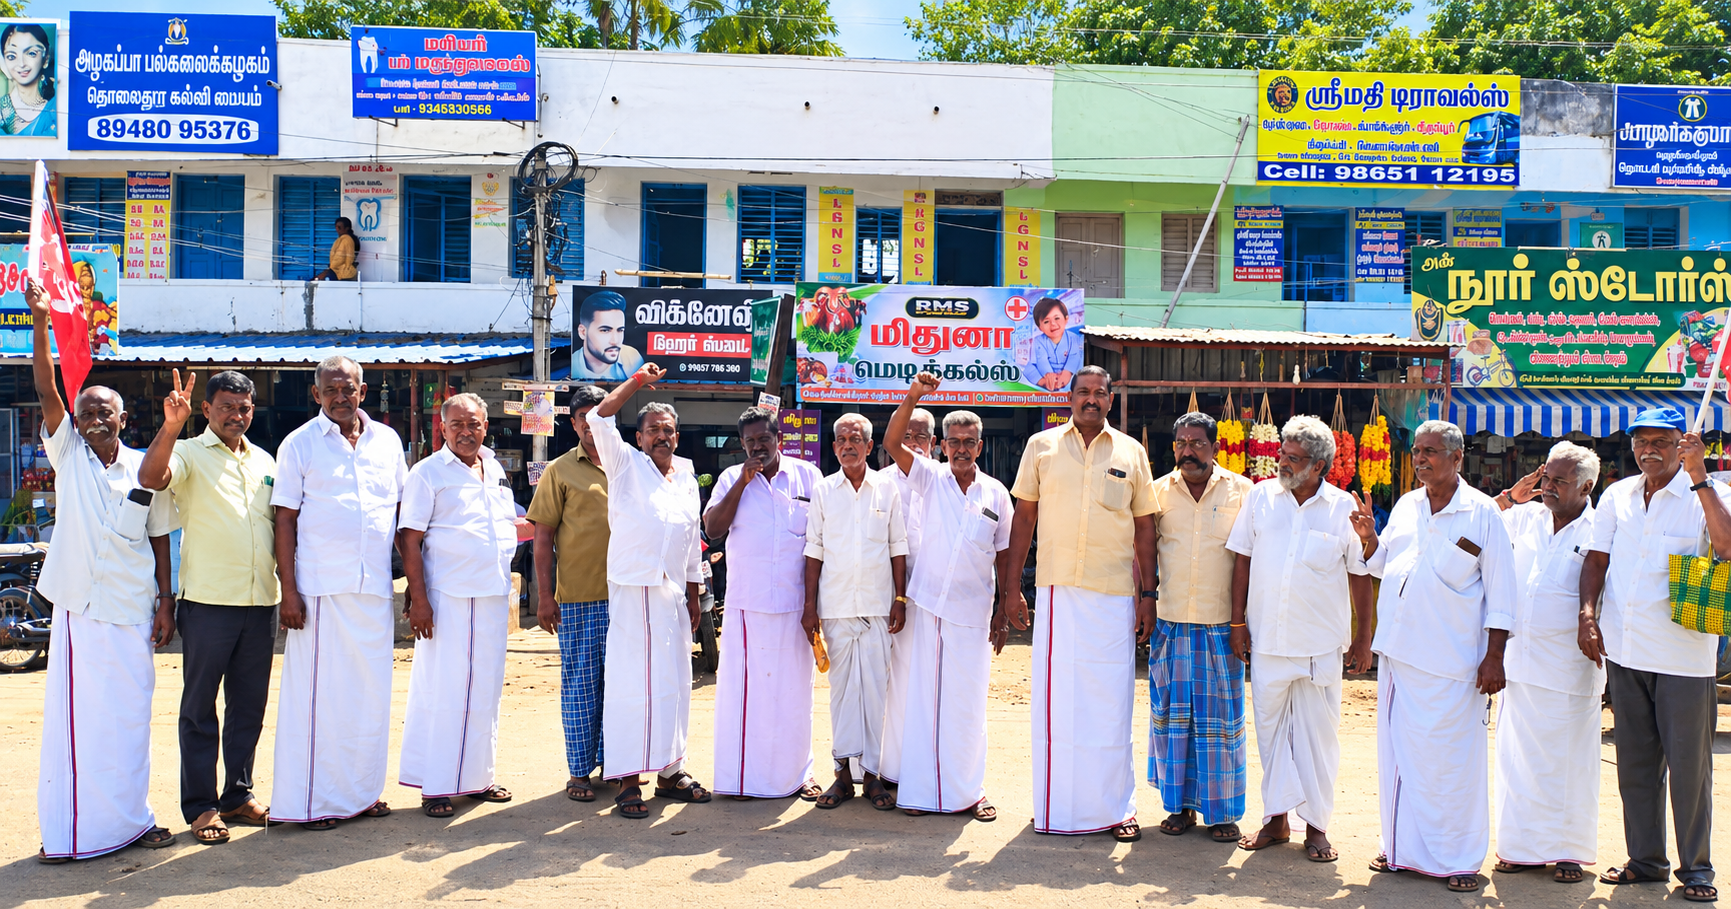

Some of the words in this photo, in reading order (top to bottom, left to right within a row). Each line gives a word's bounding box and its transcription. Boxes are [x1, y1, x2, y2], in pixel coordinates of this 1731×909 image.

[75, 44, 141, 81] அழகப்பா
[145, 45, 270, 82] பல்கலைக்கழகம்
[170, 84, 211, 106] கல்வி
[1391, 82, 1509, 112] டிராவல்ஸ்
[97, 119, 171, 139] 89480
[179, 120, 251, 140] 95376
[1264, 164, 1325, 179] Cell:
[1335, 166, 1418, 181] 98651
[1431, 167, 1515, 182] 12195
[915, 299, 970, 312] RMS
[871, 317, 1014, 355] மிதுனா
